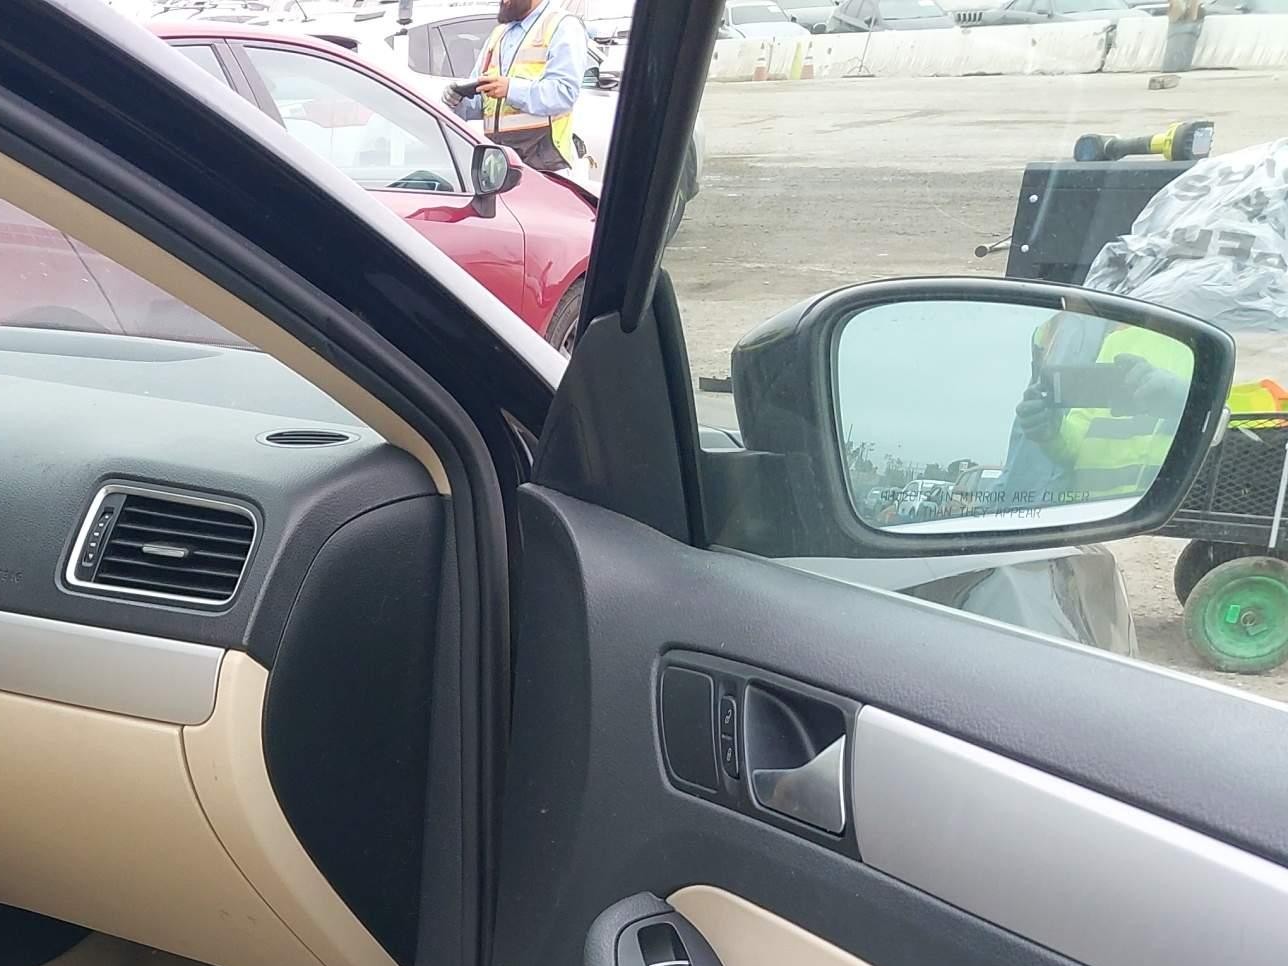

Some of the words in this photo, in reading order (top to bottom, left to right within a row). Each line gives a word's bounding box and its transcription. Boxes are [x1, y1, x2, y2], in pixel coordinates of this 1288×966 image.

[962, 490, 1006, 503] MIRROR
[1013, 490, 1036, 503] ARE
[1042, 489, 1090, 503] CLOSER
[959, 506, 988, 519] THEY
[994, 506, 1042, 519] APPEAR
